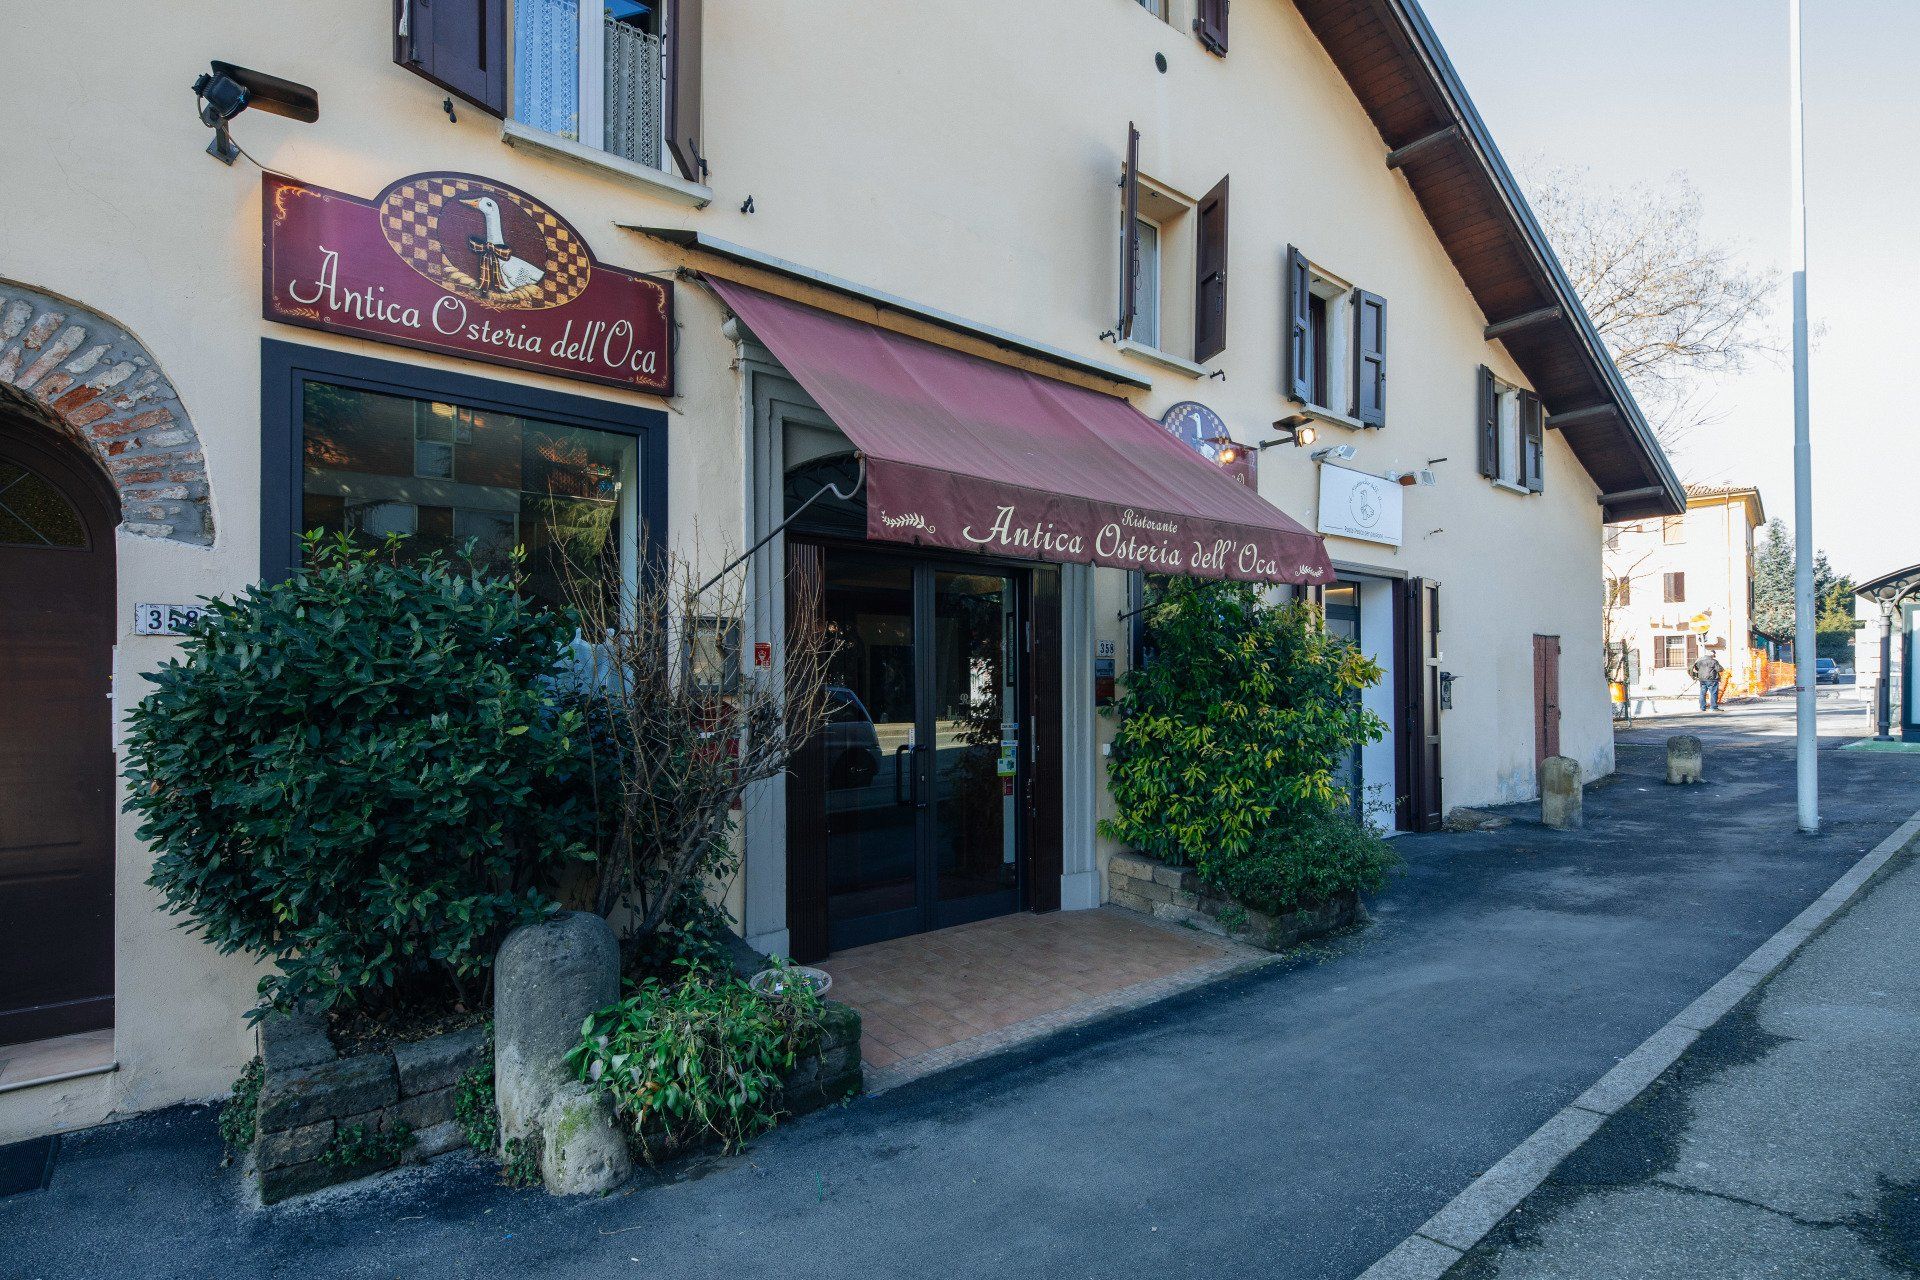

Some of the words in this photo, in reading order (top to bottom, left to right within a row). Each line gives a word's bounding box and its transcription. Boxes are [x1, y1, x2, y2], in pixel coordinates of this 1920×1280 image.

[289, 245, 421, 329] Antica
[432, 295, 542, 354] Osteria
[962, 505, 1084, 554] Antica
[1095, 523, 1182, 567] Osteria
[1121, 508, 1178, 534] Ristorante
[1099, 642, 1115, 654] 358
